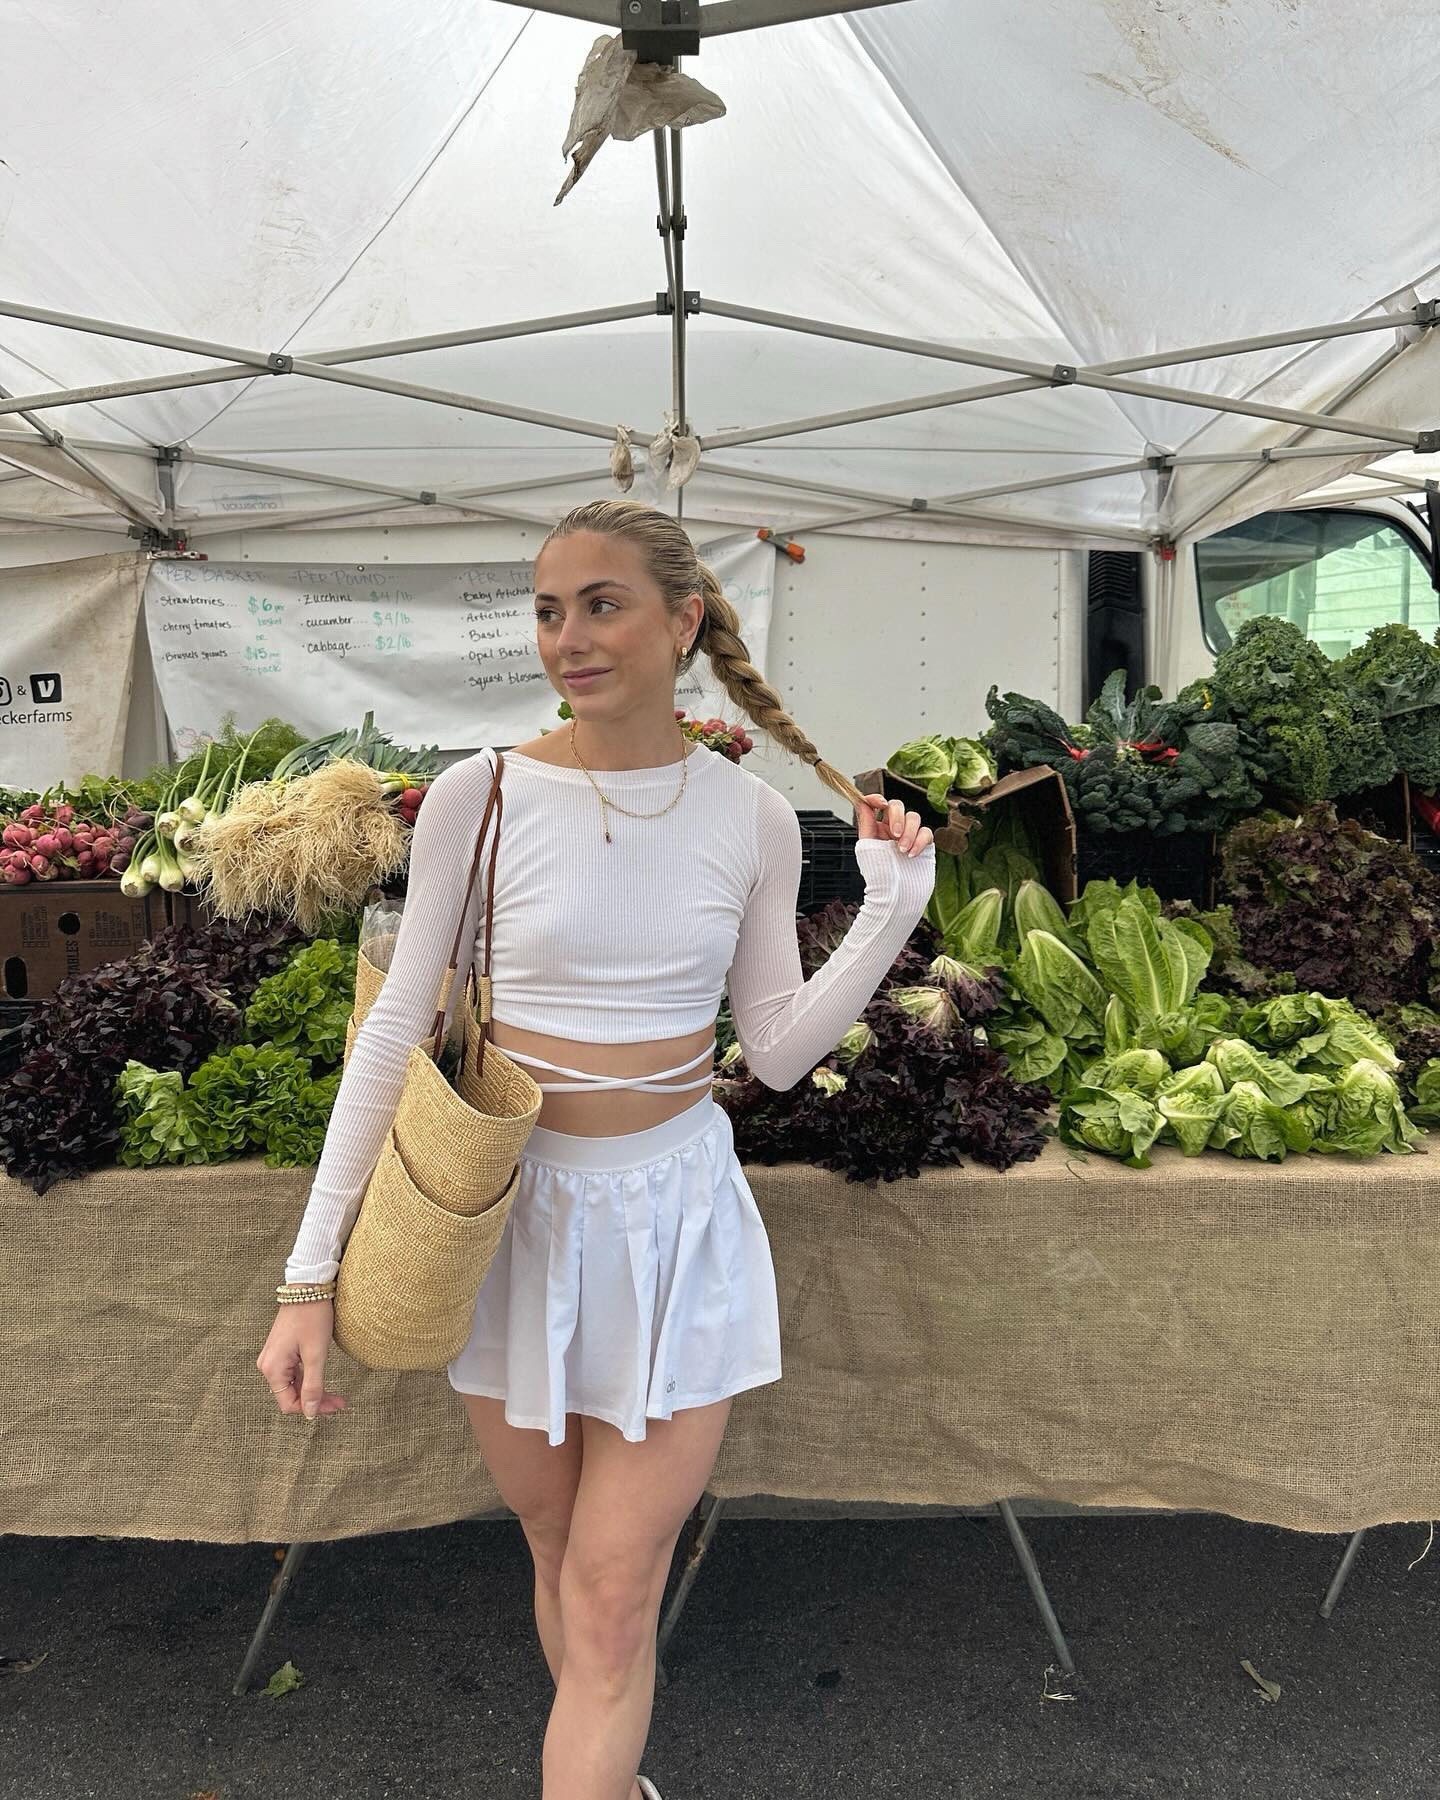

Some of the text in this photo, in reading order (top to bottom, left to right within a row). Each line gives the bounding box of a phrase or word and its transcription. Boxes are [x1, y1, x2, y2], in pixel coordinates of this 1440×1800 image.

[296, 570, 386, 585] PER POUND
[463, 592, 492, 603] Baby
[467, 609, 519, 622] Artichoke
[469, 629, 502, 641] Basil
[468, 645, 530, 664] Opal Basil
[17, 685, 27, 696] &
[0, 709, 73, 726] ckerfarms
